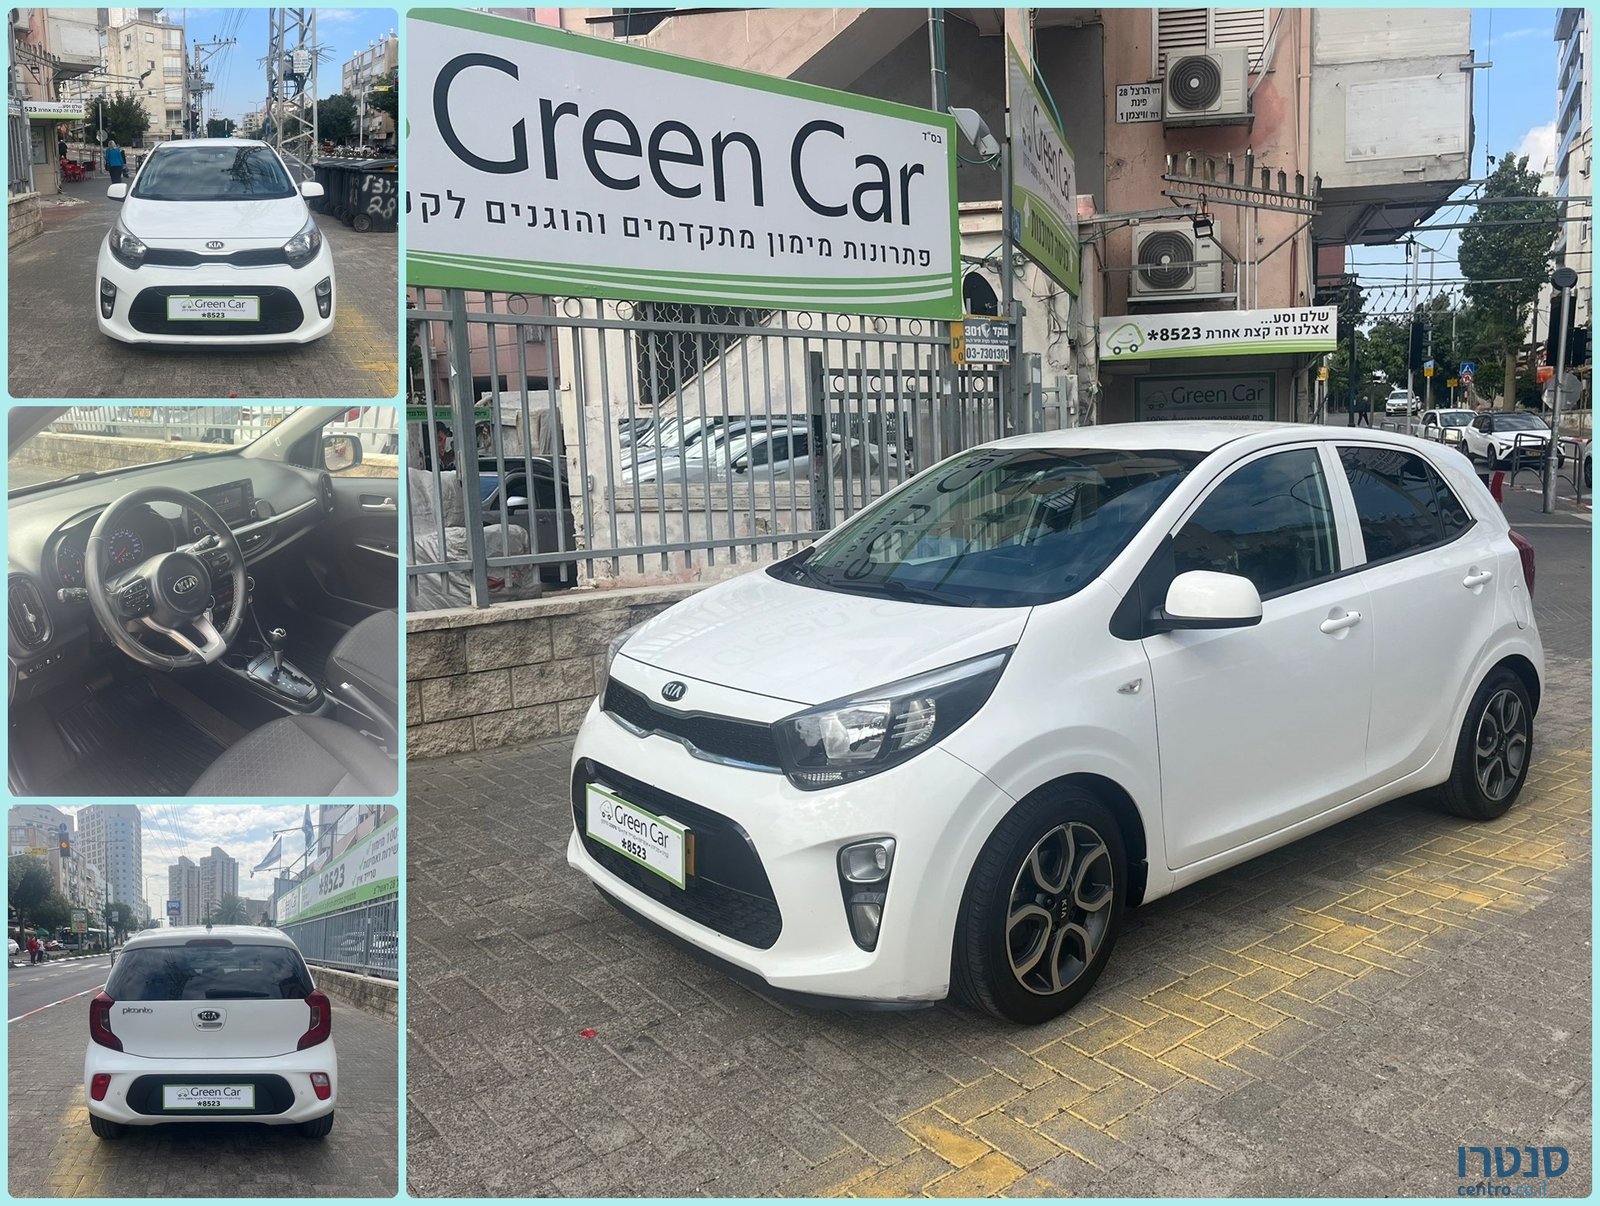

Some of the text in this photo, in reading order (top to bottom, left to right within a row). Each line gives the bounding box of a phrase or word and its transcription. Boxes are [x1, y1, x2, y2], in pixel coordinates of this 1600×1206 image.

[1119, 88, 1128, 96] 28
[1130, 86, 1150, 95] הרצל
[1131, 98, 1147, 107] פינת
[1120, 112, 1124, 120] 1
[433, 52, 764, 207] Green
[791, 119, 924, 226] Car
[922, 131, 942, 144] בס"ד
[1033, 104, 1071, 202] Green Car
[367, 196, 396, 218] 28
[485, 199, 606, 234] והוגנים
[622, 216, 755, 251] מתקדמים
[767, 232, 832, 257] מימון
[843, 240, 931, 267] פתרונות
[195, 299, 246, 309] Green Car
[1260, 310, 1329, 324] שלם וסע...
[964, 325, 981, 336] 301
[1206, 328, 1240, 339] אחרת
[1244, 327, 1270, 339] קצת
[1275, 326, 1289, 336] זה
[1293, 323, 1329, 335] אצלנו
[966, 347, 1009, 360] 03-7301301
[1171, 384, 1264, 404] Green Car
[177, 577, 196, 592] KIA
[662, 683, 683, 698] KIA
[614, 805, 648, 838] Green
[650, 822, 669, 849] Car
[190, 1087, 241, 1096] Green Car
